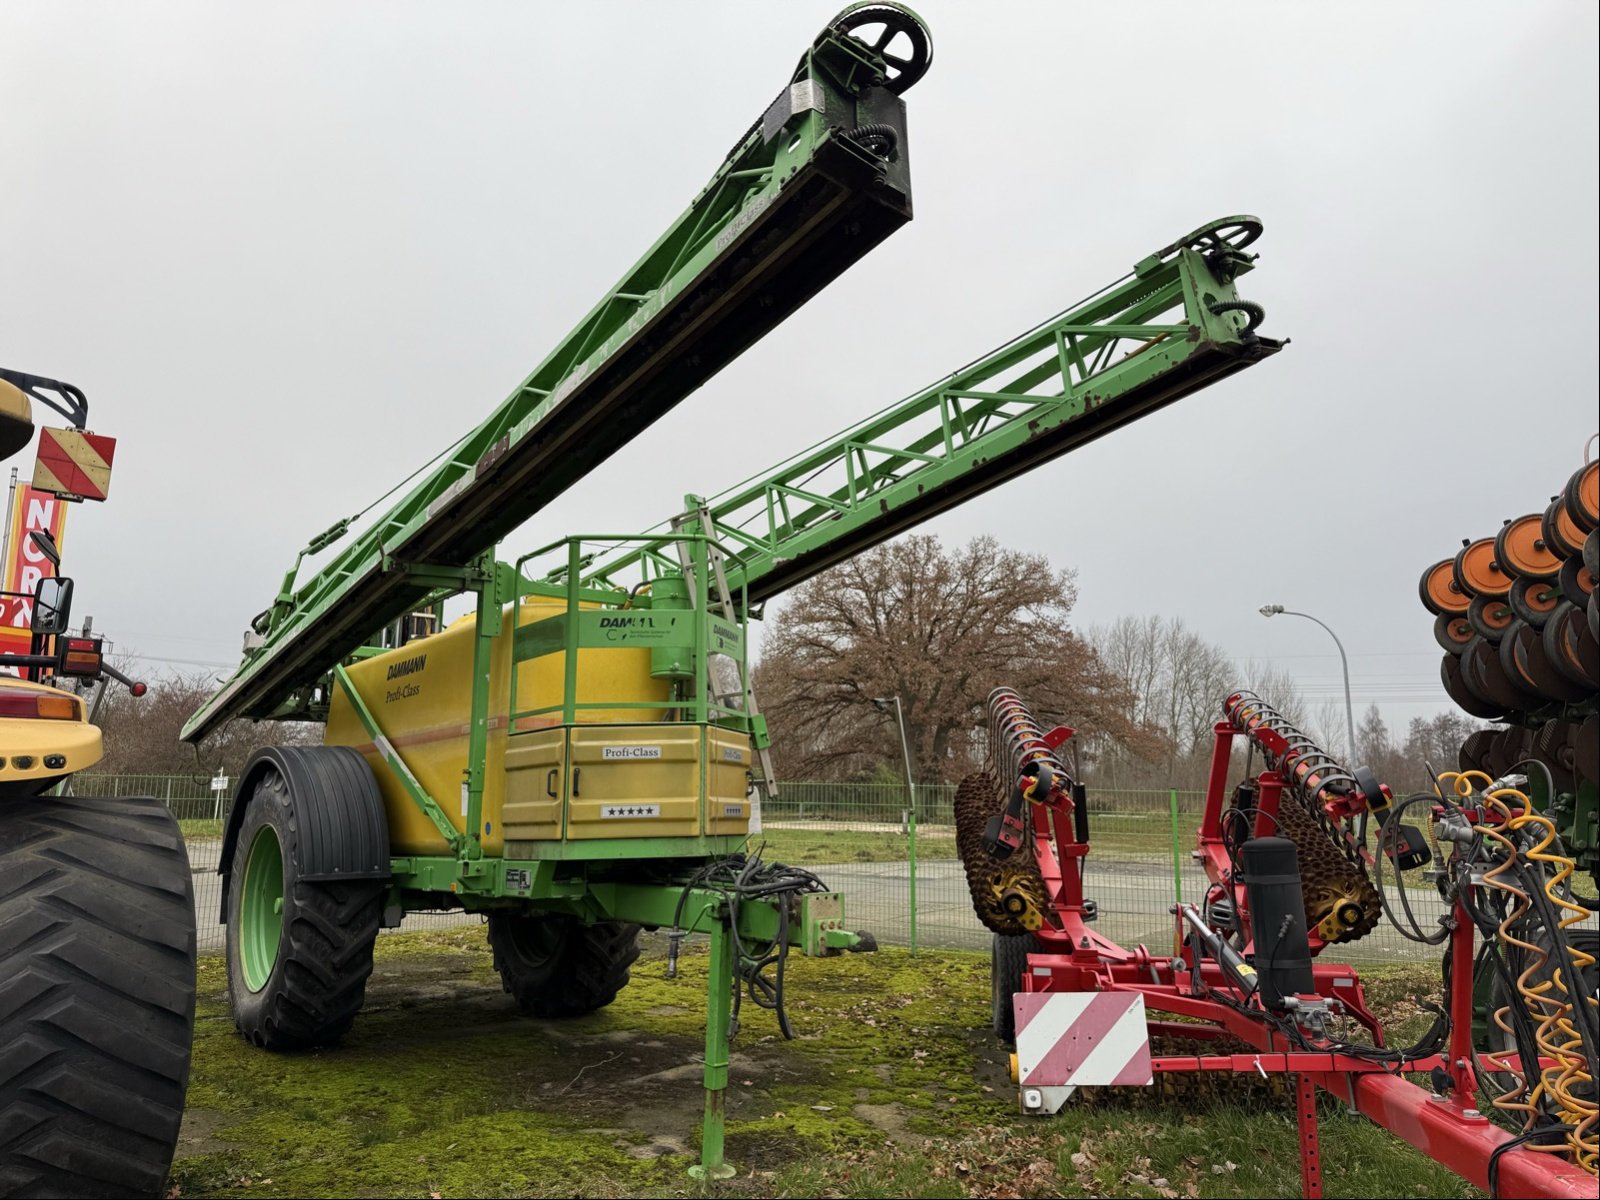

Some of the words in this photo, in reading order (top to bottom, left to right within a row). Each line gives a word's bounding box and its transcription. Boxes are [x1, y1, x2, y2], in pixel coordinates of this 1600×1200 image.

[387, 653, 427, 681] DAMMANN
[385, 683, 420, 704] Profi-Class
[605, 747, 659, 757] Profi-Class
